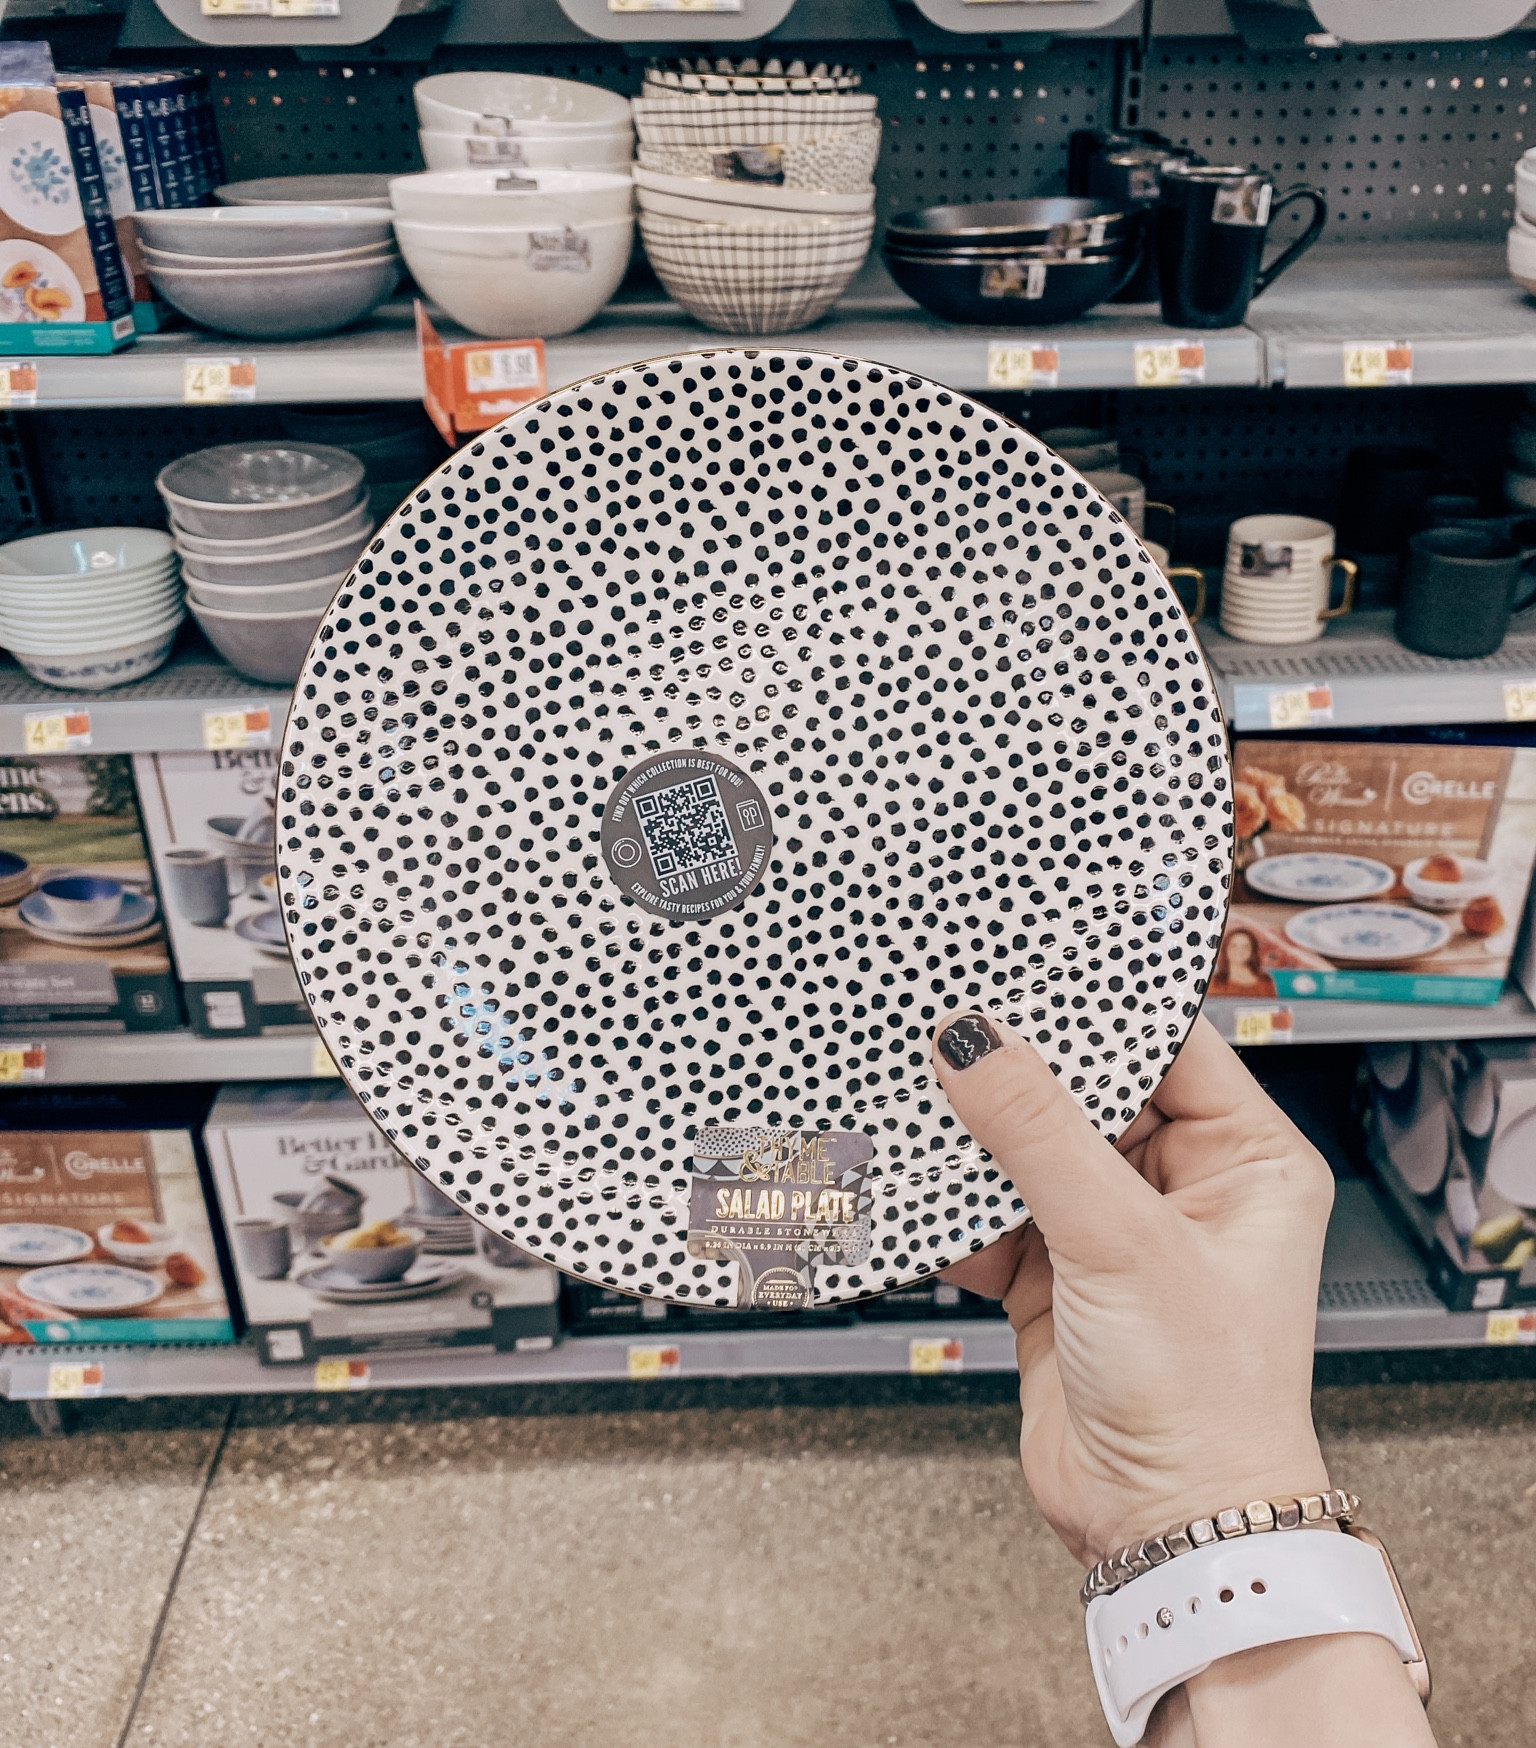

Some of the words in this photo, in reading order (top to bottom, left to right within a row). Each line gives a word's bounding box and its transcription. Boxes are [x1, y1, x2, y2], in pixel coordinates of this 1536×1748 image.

[611, 804, 625, 822] FIND
[618, 790, 632, 806] OUT
[626, 772, 649, 794] WHICH
[645, 758, 687, 779] COLLECTION
[688, 758, 696, 768] IS
[696, 758, 716, 771] BEST
[714, 764, 729, 778] FOR
[727, 771, 744, 788] YOU!
[1313, 818, 1456, 836] SIGNATURE
[749, 844, 766, 873] FAMILY!
[659, 870, 699, 898] SCAN
[700, 857, 743, 886] HERE!
[738, 870, 756, 889] YOUR
[630, 881, 660, 906] EXPLORE
[722, 889, 738, 903] YOU
[734, 885, 743, 894] &
[658, 898, 681, 913] TASTY
[681, 901, 711, 914] RECIPES
[710, 896, 725, 910] FOR
[756, 1135, 836, 1162] THYME
[739, 1149, 771, 1183] &
[772, 1160, 837, 1185] TABLE
[714, 1187, 785, 1220] SALAD
[790, 1189, 857, 1222] PLATE
[710, 1225, 771, 1235] DURABLE
[736, 1242, 752, 1250] DIA
[772, 1243, 784, 1251] IN
[758, 1291, 803, 1300] EVERYDAY
[772, 1299, 789, 1308] USE
